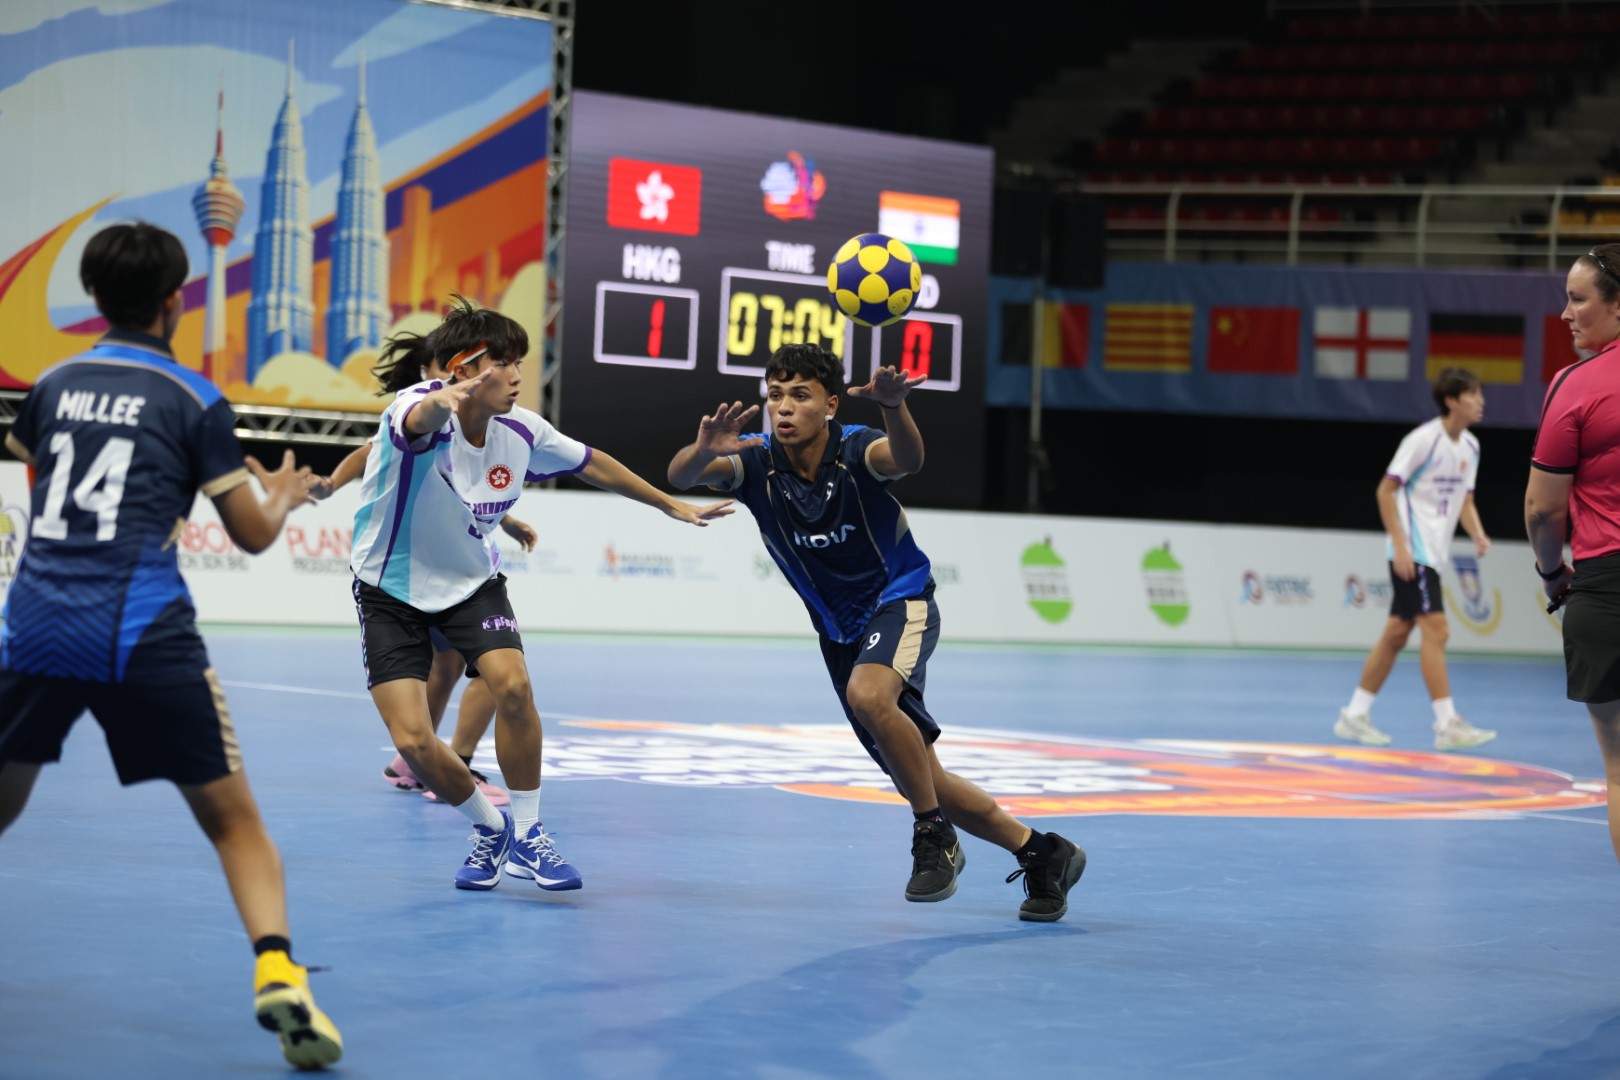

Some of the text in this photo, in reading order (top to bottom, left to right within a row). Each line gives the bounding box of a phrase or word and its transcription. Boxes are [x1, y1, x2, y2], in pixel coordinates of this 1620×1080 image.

[622, 243, 682, 283] HKG
[646, 299, 666, 358] 1
[56, 389, 146, 427] MILLEE
[31, 431, 135, 542] 14
[866, 632, 881, 650] 9
